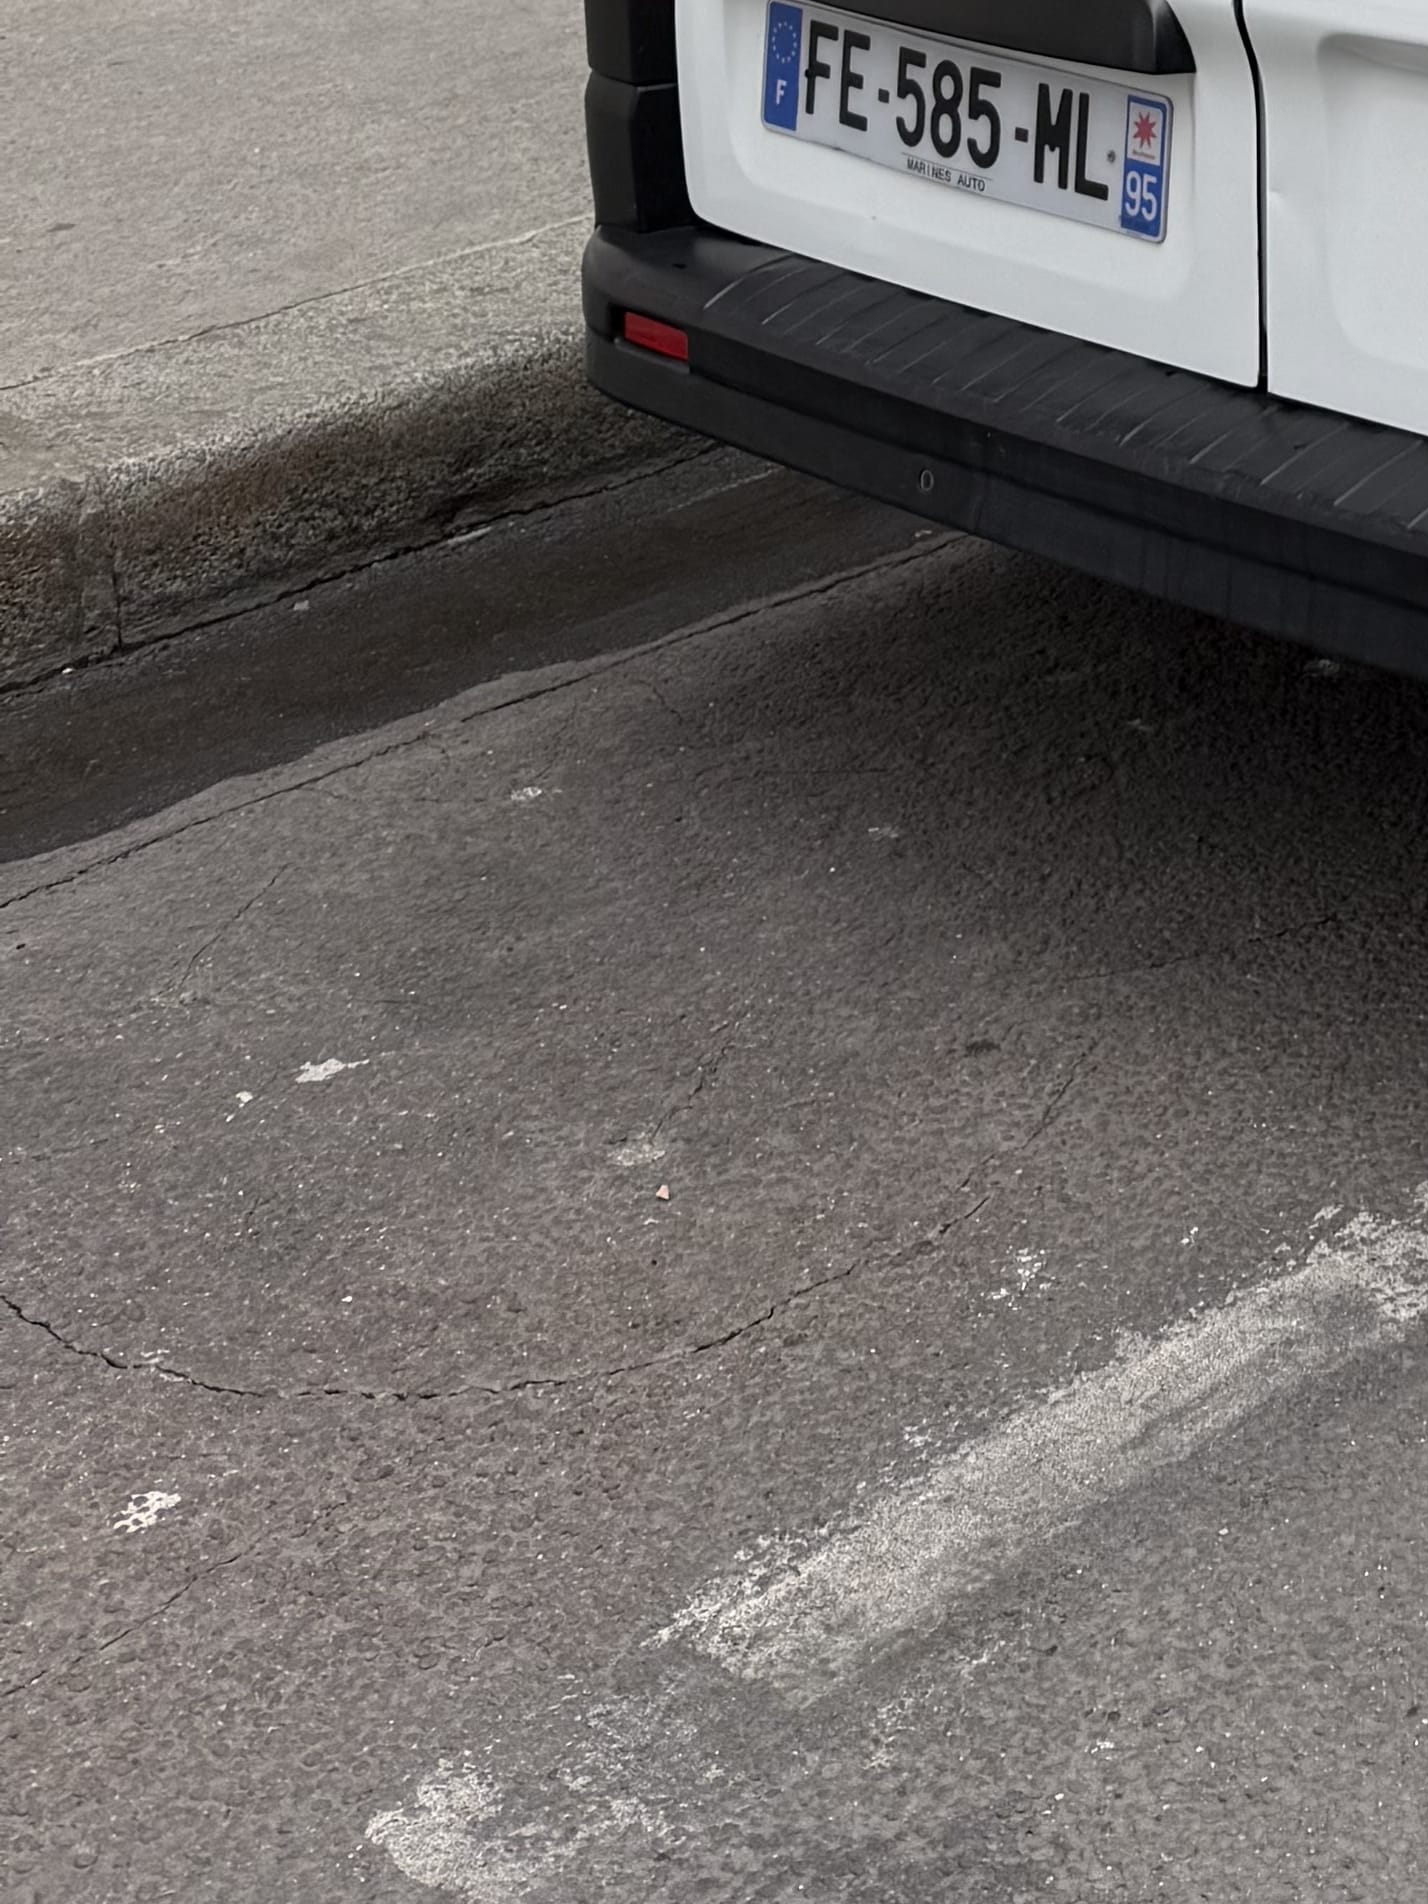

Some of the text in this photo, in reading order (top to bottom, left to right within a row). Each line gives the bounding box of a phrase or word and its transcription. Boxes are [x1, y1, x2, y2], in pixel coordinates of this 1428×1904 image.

[774, 79, 788, 106] F
[804, 19, 1109, 202] FE-585-ML
[906, 157, 986, 192] MARINES AUTO
[1124, 170, 1158, 222] 95
